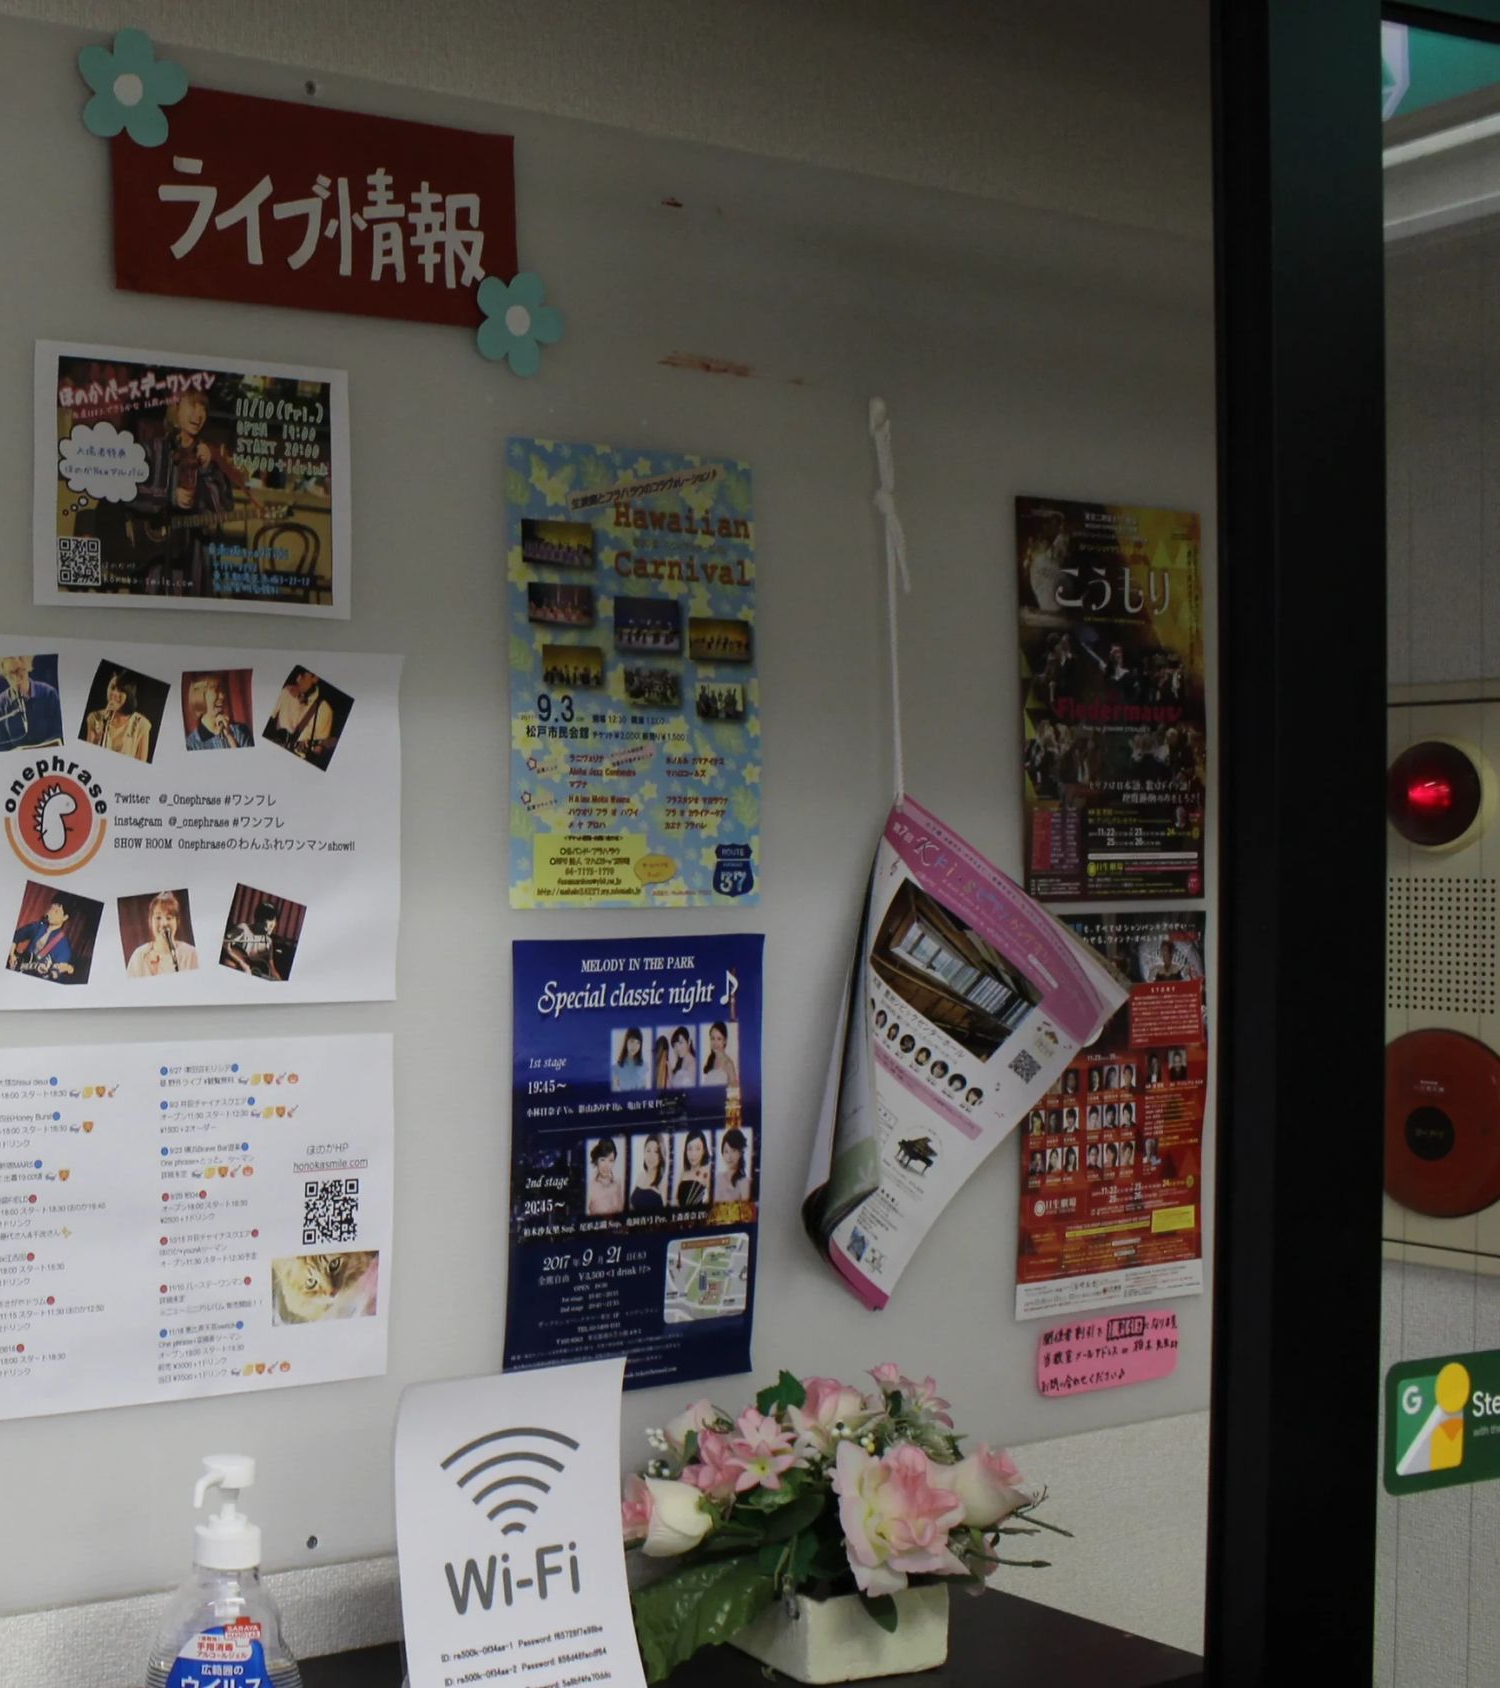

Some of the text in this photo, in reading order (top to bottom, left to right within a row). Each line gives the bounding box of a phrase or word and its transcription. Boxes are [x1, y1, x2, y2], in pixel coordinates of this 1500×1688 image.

[157, 154, 486, 290] ライブ情報
[59, 371, 216, 407] ほのかバースデーワンマン
[236, 437, 320, 459] START 20:00
[613, 497, 751, 540] Hawaiian
[613, 551, 752, 587] Carnival
[1054, 566, 1170, 616] こうもり
[536, 693, 575, 723] 9.3
[526, 726, 590, 740] 松戸市民会館
[4, 754, 108, 815] onephrase
[114, 792, 277, 808] Twitter @_Onephrase #ワンフレ
[114, 815, 285, 830] instagram @_onephrase #ワンフレ
[114, 838, 143, 850] SHOW
[145, 838, 173, 850] ROOM
[720, 870, 747, 893] 37
[580, 955, 695, 973] MELODY IN THE PARK
[537, 978, 715, 1018] Special classic night
[543, 1056, 567, 1071] stage
[292, 1158, 369, 1174] honokasmile.com
[525, 1175, 569, 1190] 2nd stage
[444, 1541, 581, 1615] Wi-Fi
[227, 1624, 259, 1632] SARAYA
